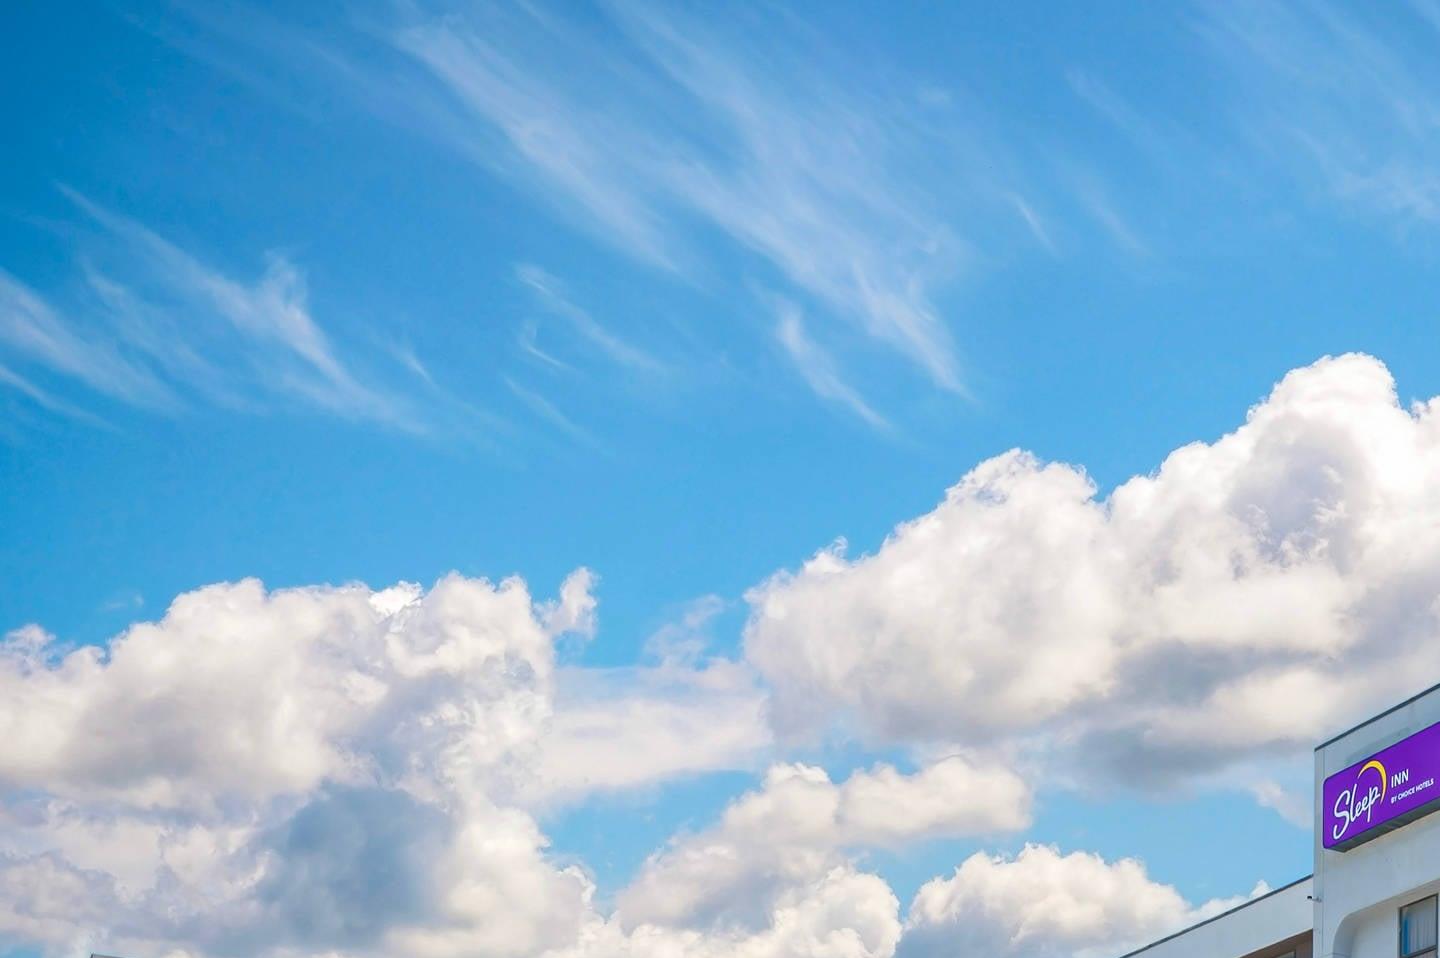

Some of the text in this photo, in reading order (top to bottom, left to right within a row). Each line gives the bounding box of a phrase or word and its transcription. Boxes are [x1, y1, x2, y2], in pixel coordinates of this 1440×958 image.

[1333, 768, 1409, 840] Sleep INN
[1391, 778, 1434, 804] BY CHOICE HOTELS
